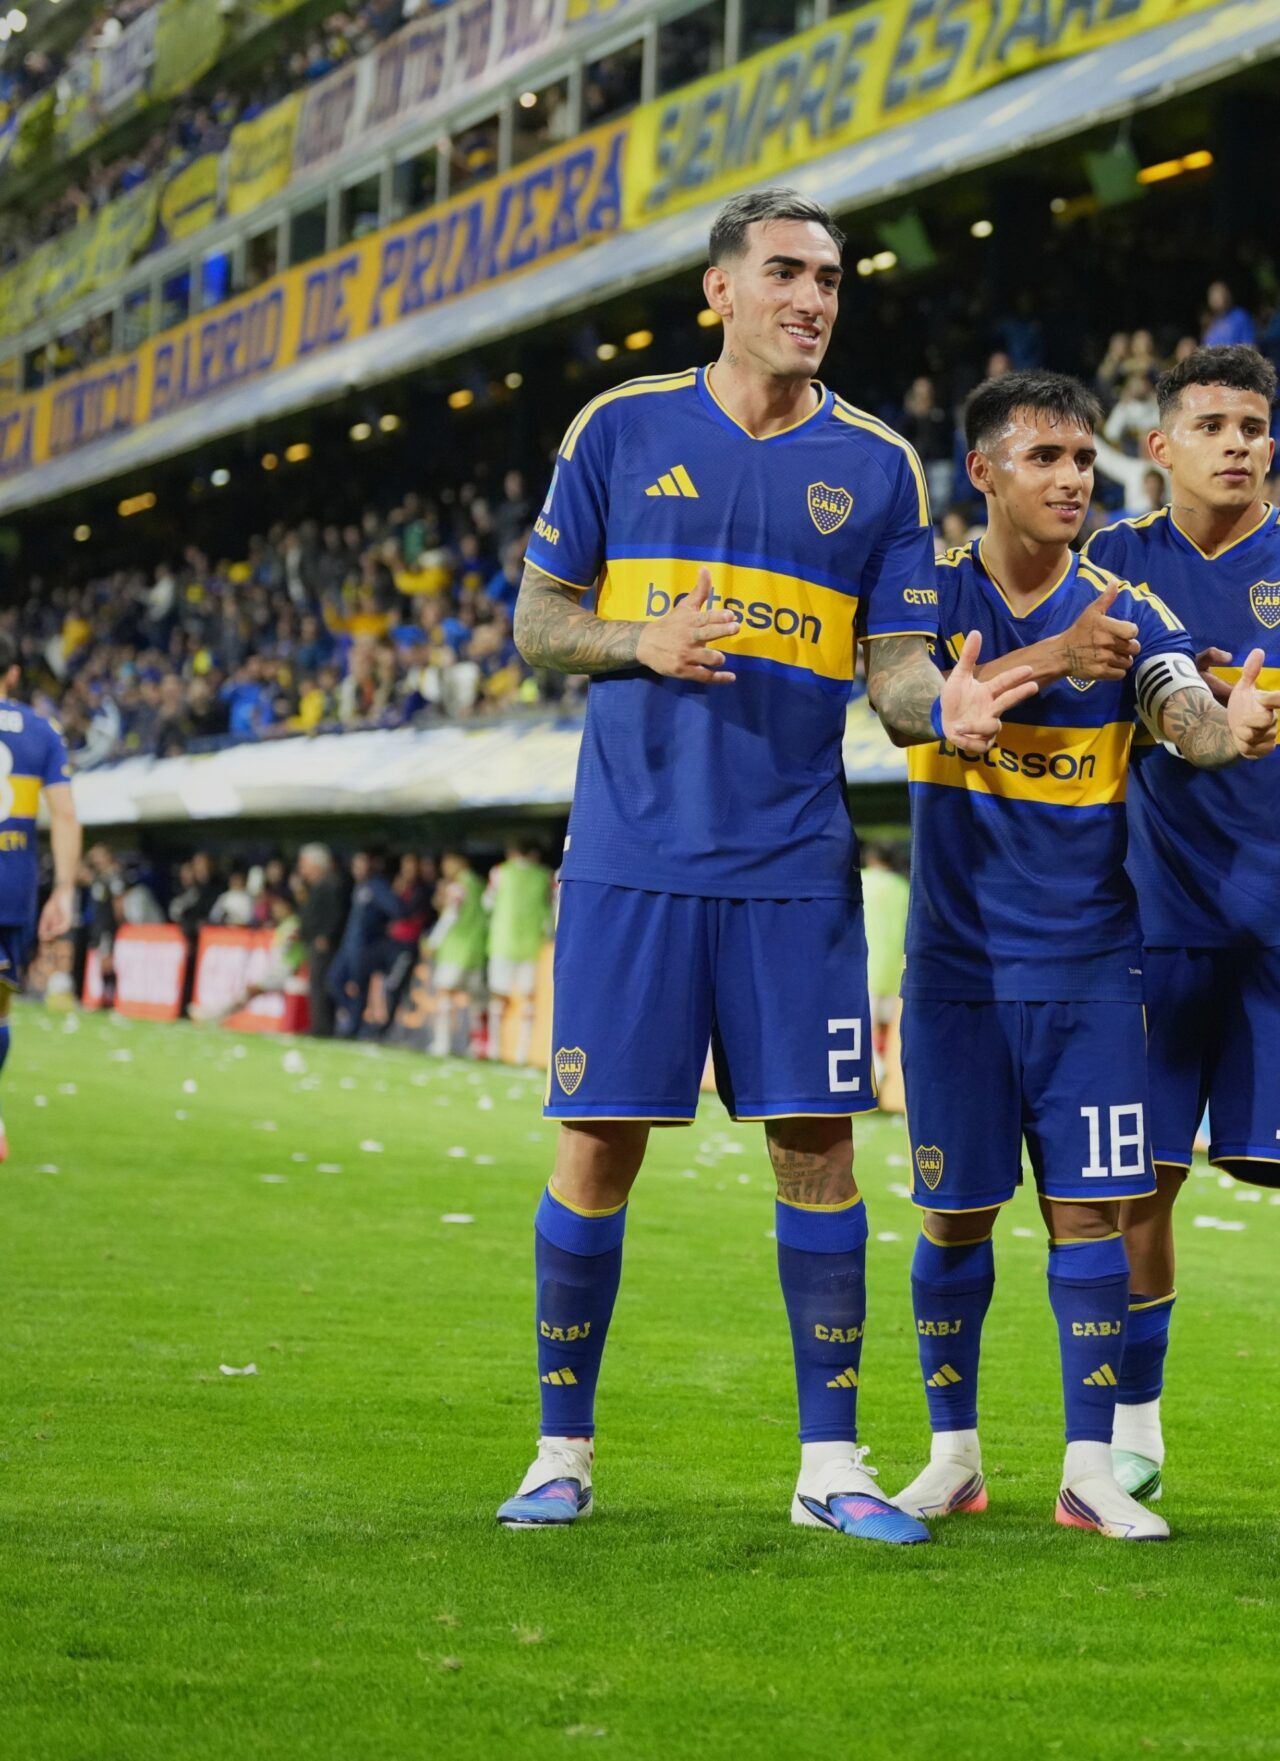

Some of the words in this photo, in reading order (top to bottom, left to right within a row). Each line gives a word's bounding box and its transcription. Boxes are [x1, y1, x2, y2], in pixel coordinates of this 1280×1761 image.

[645, 14, 882, 210] SIEMPRE
[882, 0, 1145, 108] ESTA
[299, 253, 358, 354] DE
[370, 130, 628, 328] PRIMERA
[811, 497, 845, 515] CABJ
[646, 583, 822, 644] btsson
[903, 588, 938, 605] CETR
[828, 1018, 861, 1092] 2
[1080, 1102, 1145, 1177] 18
[540, 1320, 591, 1341] CABJ
[917, 1319, 962, 1336] CABJ
[1071, 1320, 1121, 1337] CABJ
